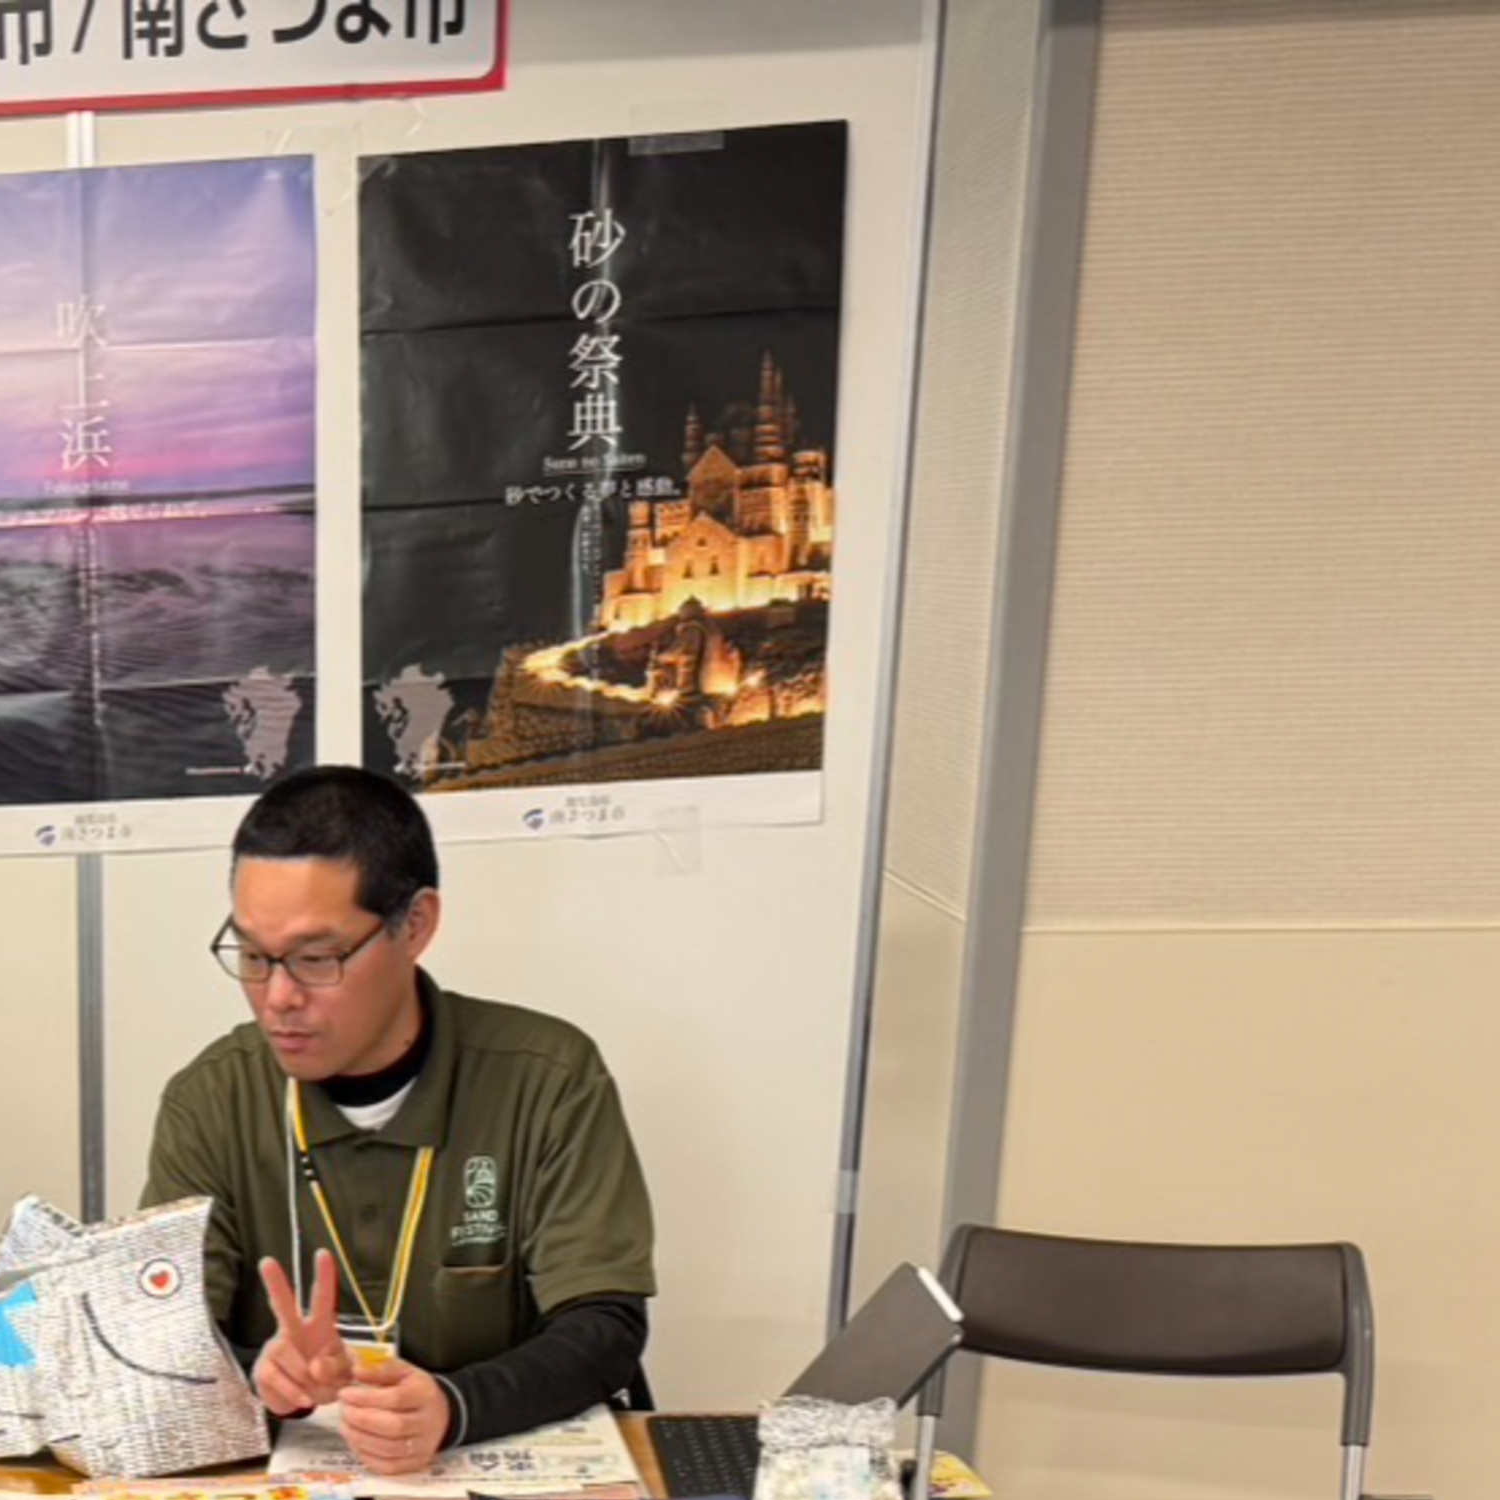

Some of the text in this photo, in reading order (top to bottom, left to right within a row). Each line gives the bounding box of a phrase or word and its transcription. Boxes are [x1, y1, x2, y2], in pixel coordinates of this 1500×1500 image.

[57, 294, 112, 470] 吹上浜
[567, 208, 626, 451] 砂の祭典
[462, 1209, 500, 1222] SAND
